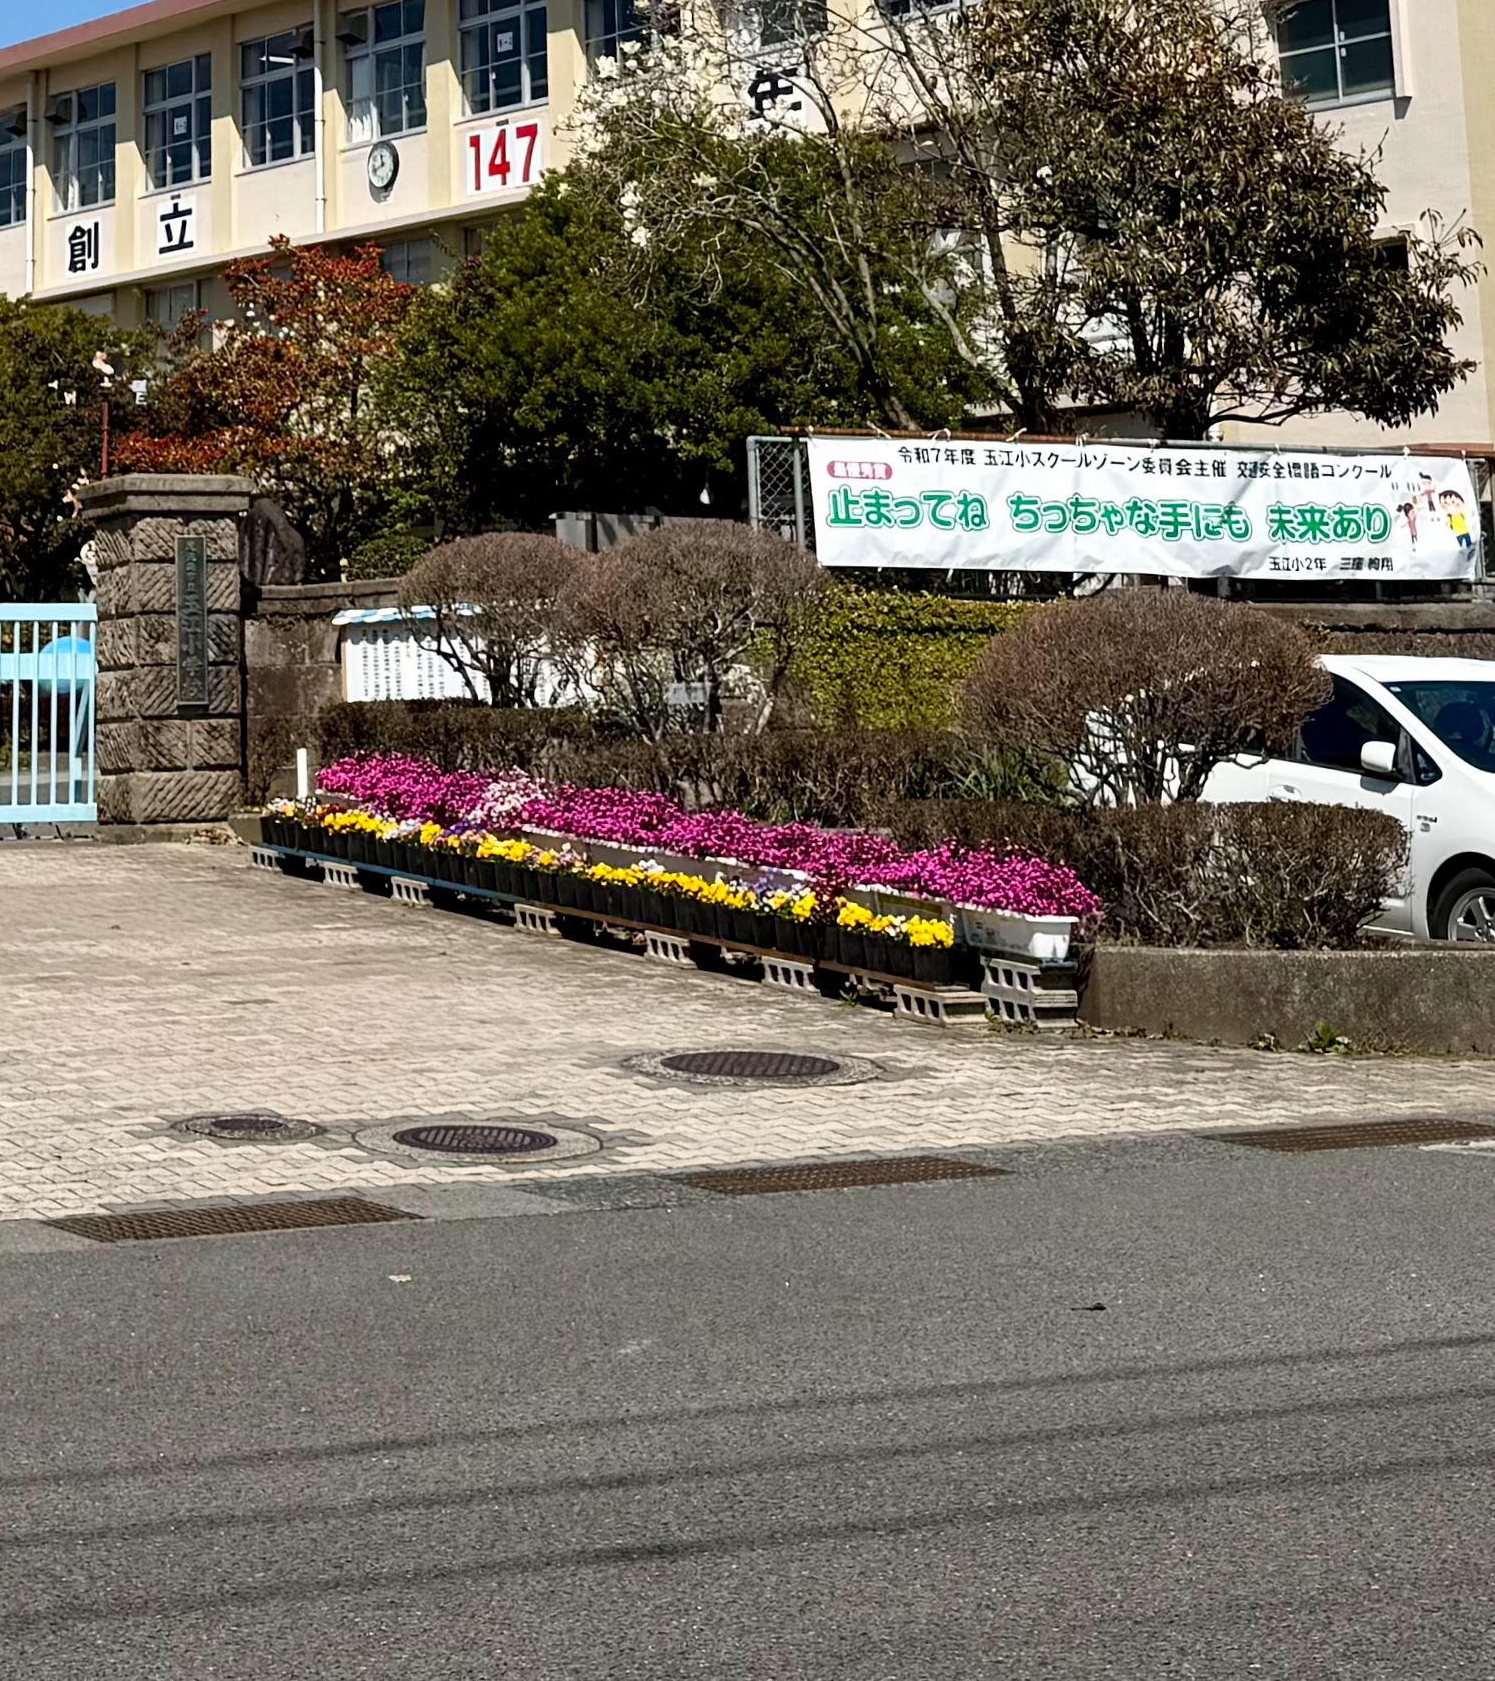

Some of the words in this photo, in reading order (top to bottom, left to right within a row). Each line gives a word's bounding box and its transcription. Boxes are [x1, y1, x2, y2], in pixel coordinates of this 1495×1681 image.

[68, 222, 99, 273] 創
[158, 202, 194, 255] 立
[468, 122, 539, 192] 147
[898, 446, 976, 466] 令和7年度
[828, 486, 989, 530] 止まってね
[1008, 492, 1251, 540] ちっちゃな手にも
[1268, 502, 1391, 543] 未来あり
